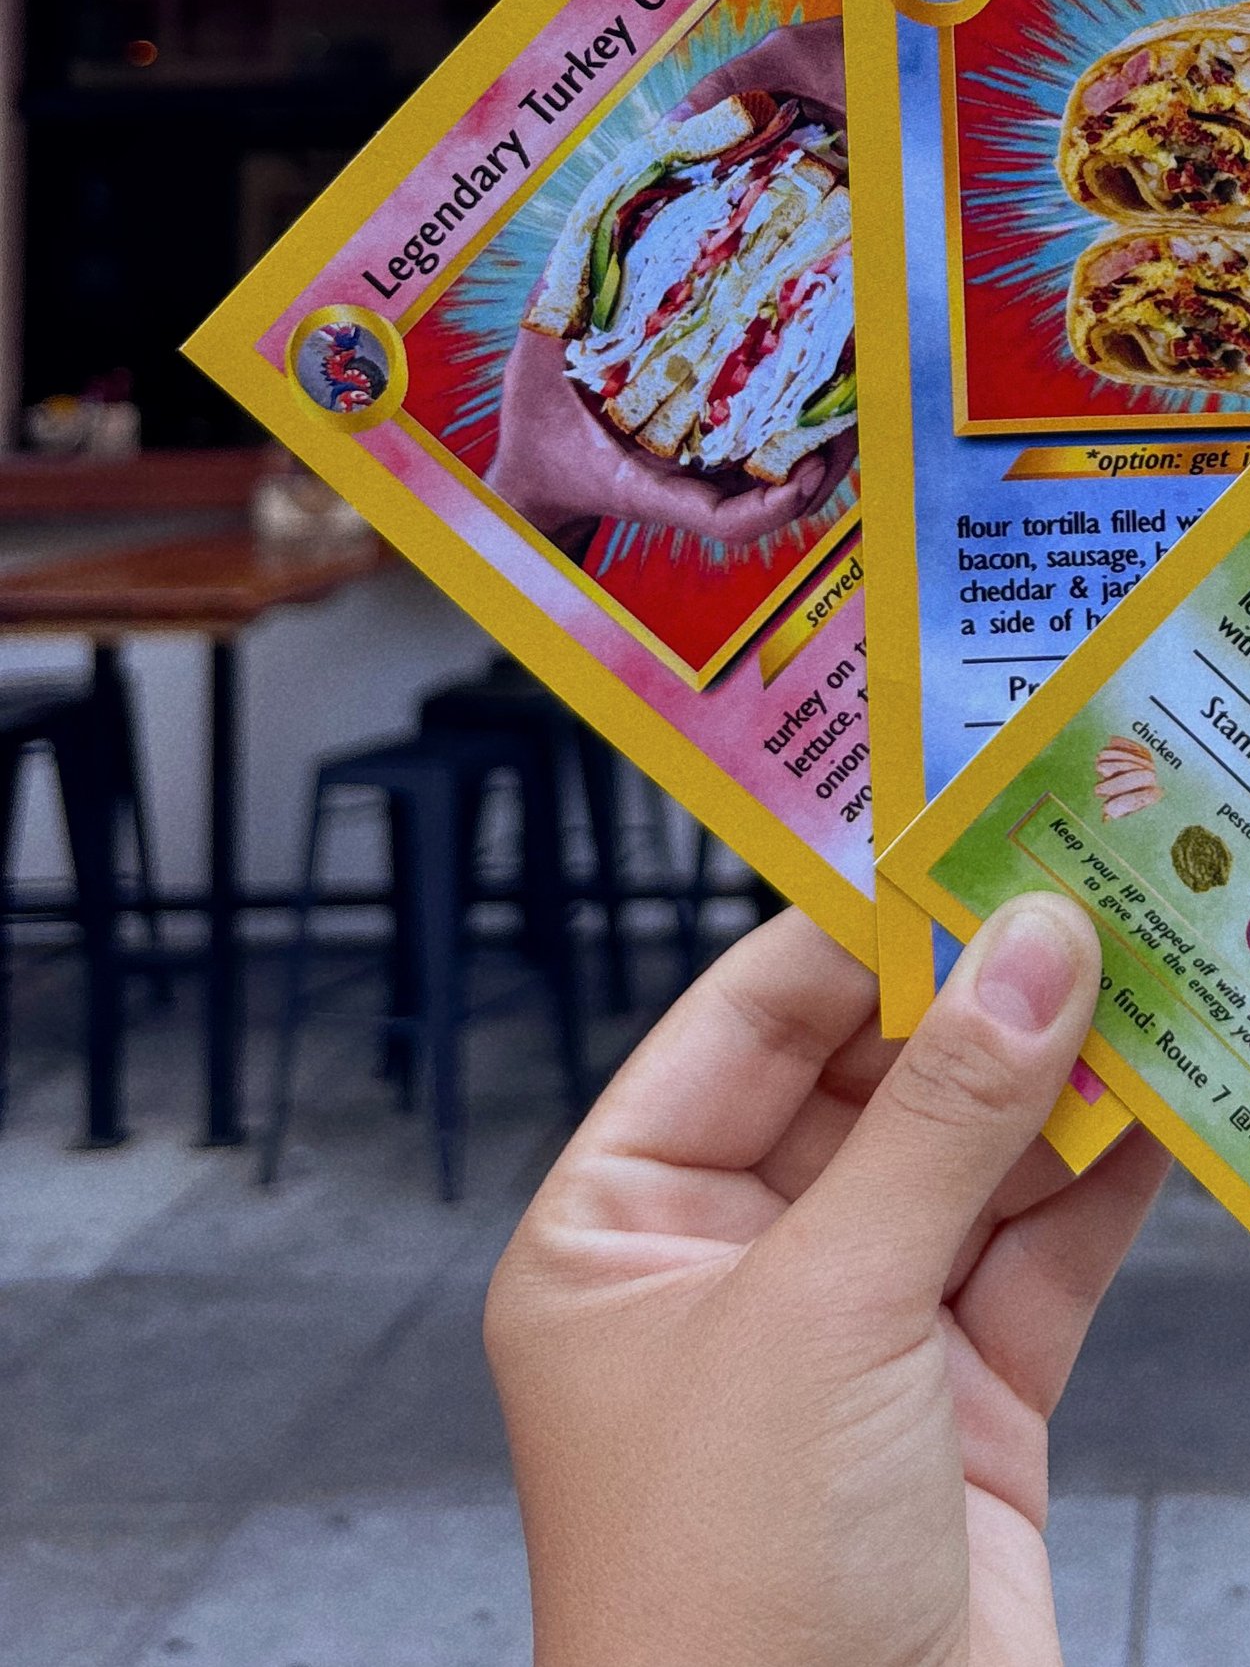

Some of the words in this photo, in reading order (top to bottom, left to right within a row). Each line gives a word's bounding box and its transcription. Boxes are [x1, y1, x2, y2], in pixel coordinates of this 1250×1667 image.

[360, 128, 531, 301] Legendary
[516, 14, 638, 125] Turkey
[1188, 449, 1231, 476] get
[956, 514, 1010, 539] flour
[1021, 510, 1102, 537] tortilla
[1109, 508, 1166, 534] filled
[958, 547, 1038, 572] bacon,
[1046, 548, 1147, 574] sausage,
[959, 576, 1057, 604] cheddar
[1068, 574, 1089, 600] &
[807, 559, 865, 627] served
[960, 618, 977, 636] a
[989, 609, 1035, 635] side
[1048, 608, 1073, 633] of
[763, 688, 828, 755] turkey
[825, 659, 856, 690] on
[782, 711, 862, 779] lettuce,
[815, 742, 871, 800] onion
[1131, 720, 1183, 771] chicken
[1048, 817, 1084, 851] Keep
[1080, 852, 1120, 882] your
[1118, 883, 1146, 904] HP
[1143, 908, 1196, 959] topped
[1192, 957, 1220, 977] off
[1215, 978, 1246, 1010] with
[1082, 875, 1101, 892] to
[1097, 894, 1132, 922] give
[1127, 923, 1161, 951] you
[1161, 952, 1187, 976] the
[1187, 979, 1235, 1023] energy
[1112, 987, 1156, 1034] find:
[1154, 1028, 1208, 1089] Route
[1211, 1083, 1232, 1103] 7
